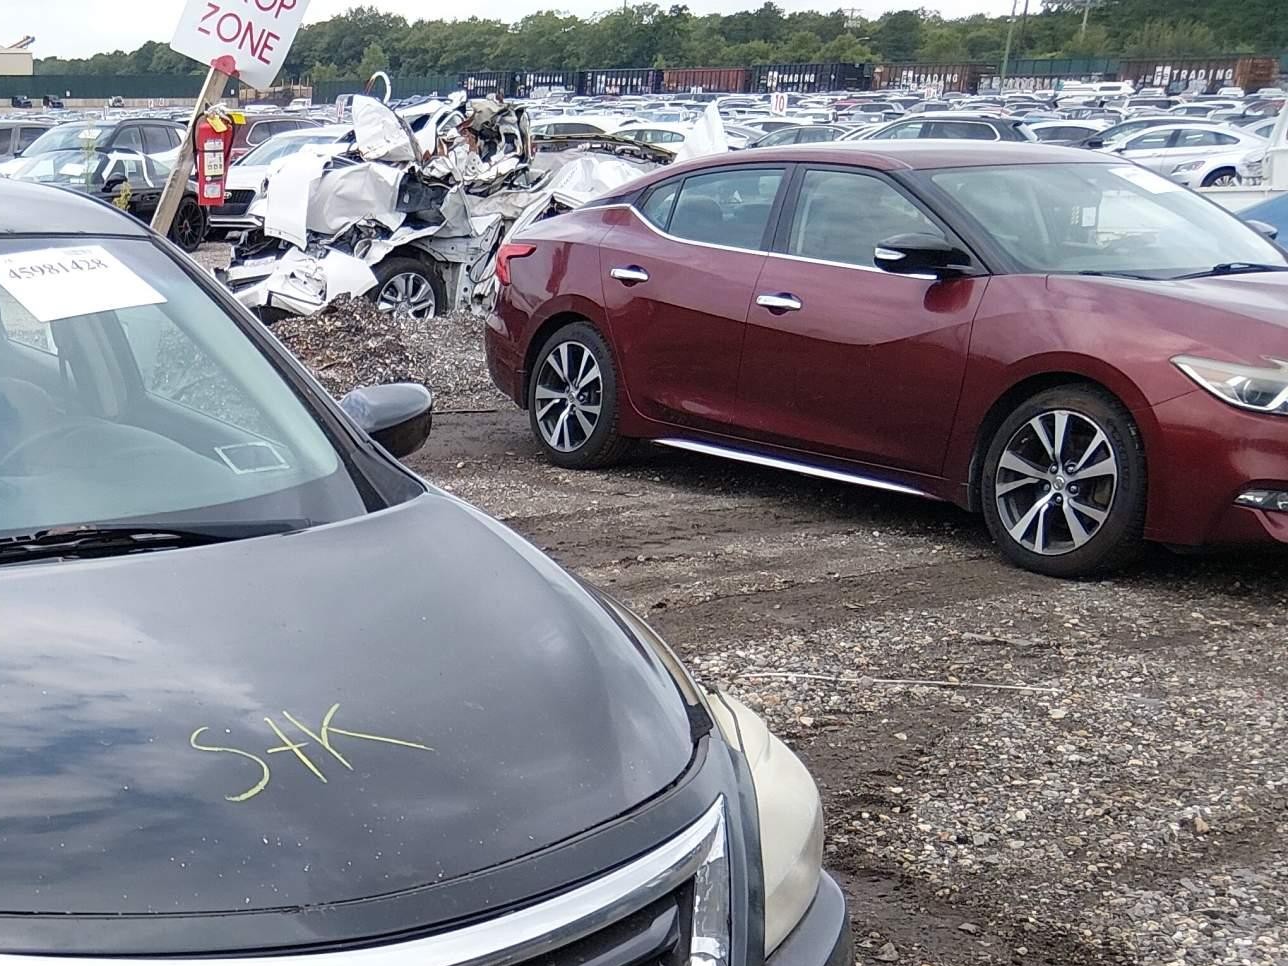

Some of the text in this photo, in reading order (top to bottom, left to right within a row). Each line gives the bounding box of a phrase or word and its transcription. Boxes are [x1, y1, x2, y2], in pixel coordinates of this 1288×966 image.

[198, 2, 280, 65] ZONE
[778, 73, 815, 83] TRADING
[914, 73, 958, 84] TRADING
[1172, 68, 1233, 81] TRADING
[8, 258, 109, 280] 45981428
